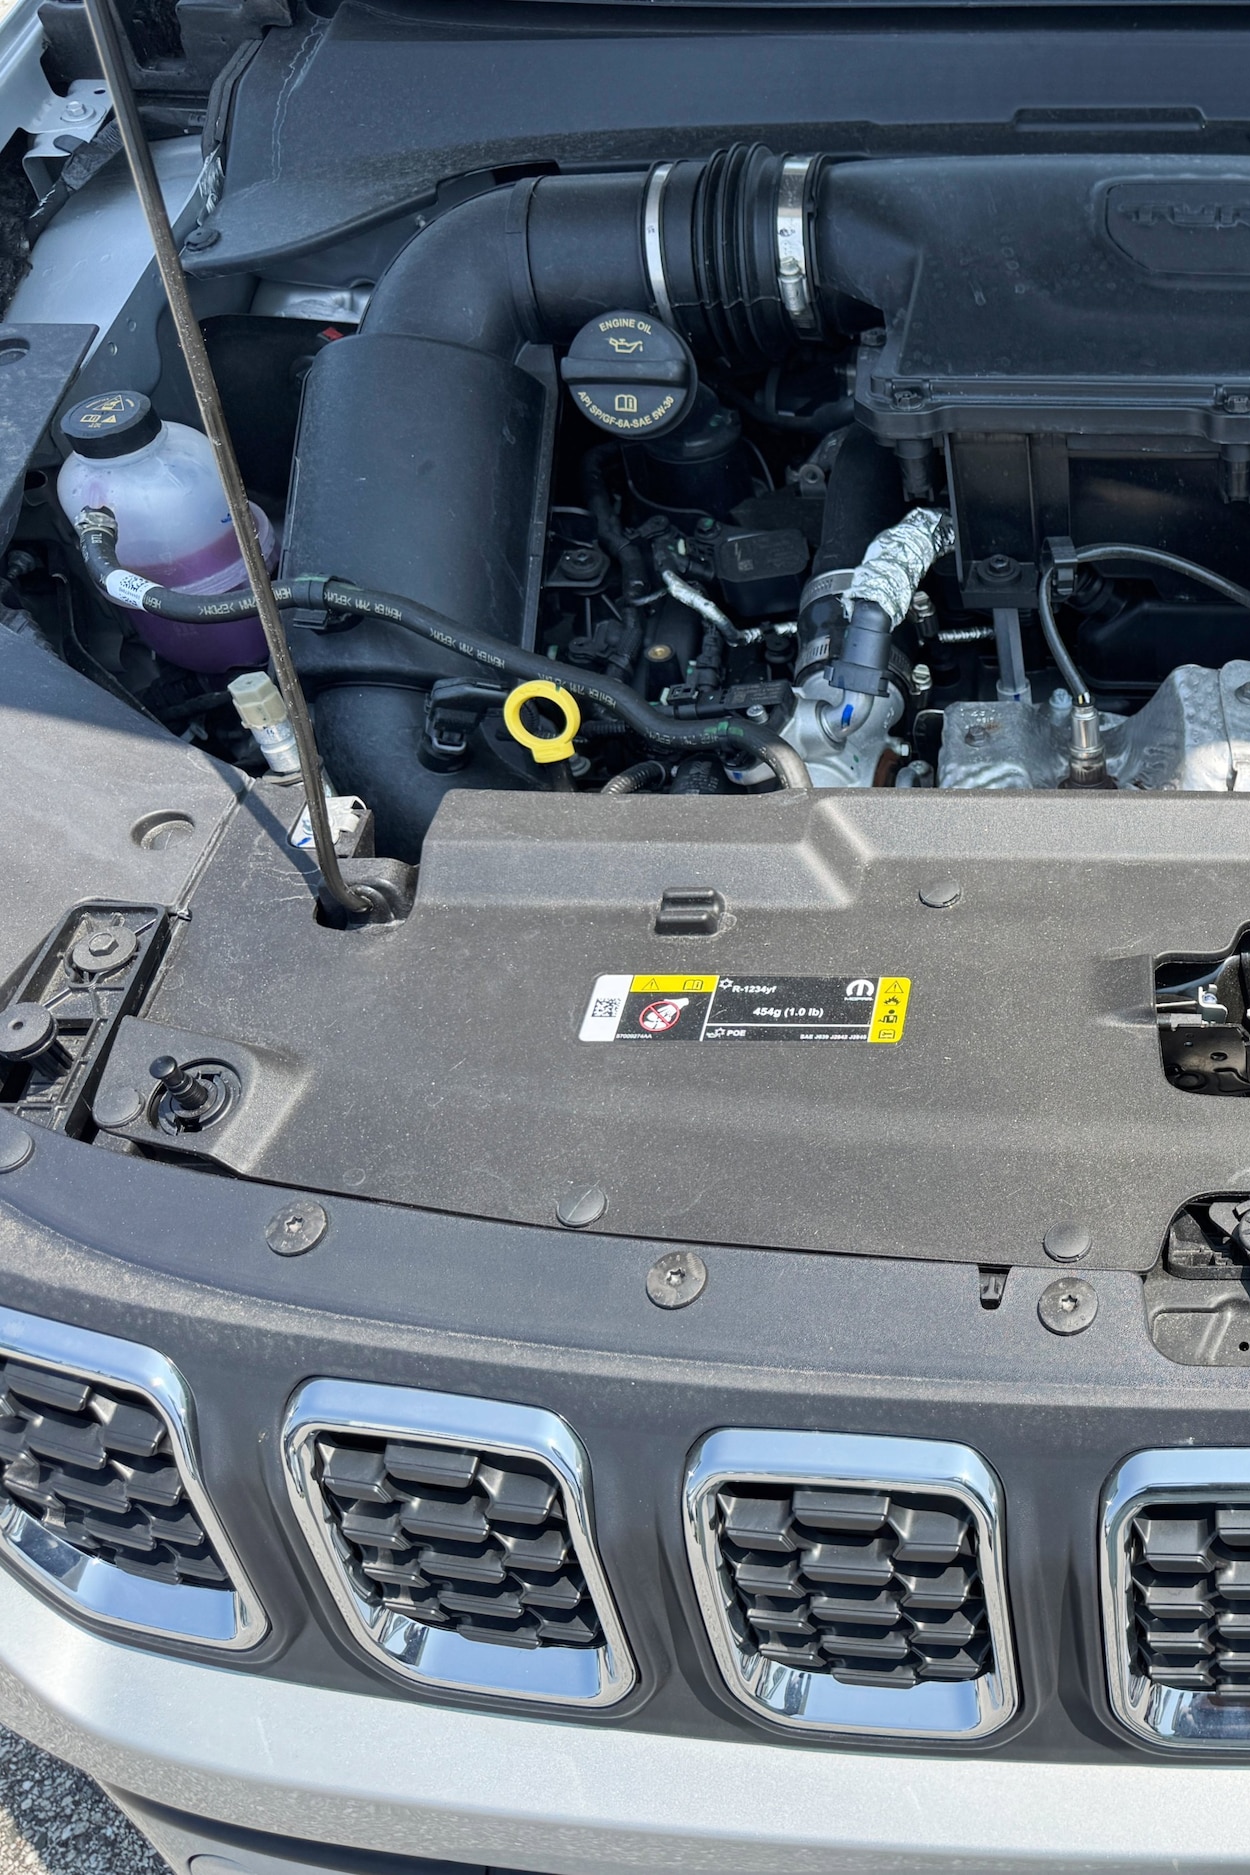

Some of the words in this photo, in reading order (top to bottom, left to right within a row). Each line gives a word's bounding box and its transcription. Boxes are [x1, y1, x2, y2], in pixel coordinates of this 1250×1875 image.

[599, 318, 635, 332] ENGINE
[637, 321, 652, 335] OIL
[578, 391, 592, 407] API
[589, 404, 652, 429] SP/GF-6A-SAE
[652, 395, 674, 420] 5W-30
[374, 603, 402, 620] HEATER
[477, 649, 505, 669] HEATER
[732, 985, 777, 994] R-1234yf
[752, 1007, 782, 1018] 454g
[784, 1007, 806, 1018] (1.0
[808, 1007, 824, 1018] lb)
[726, 1029, 746, 1037] POE
